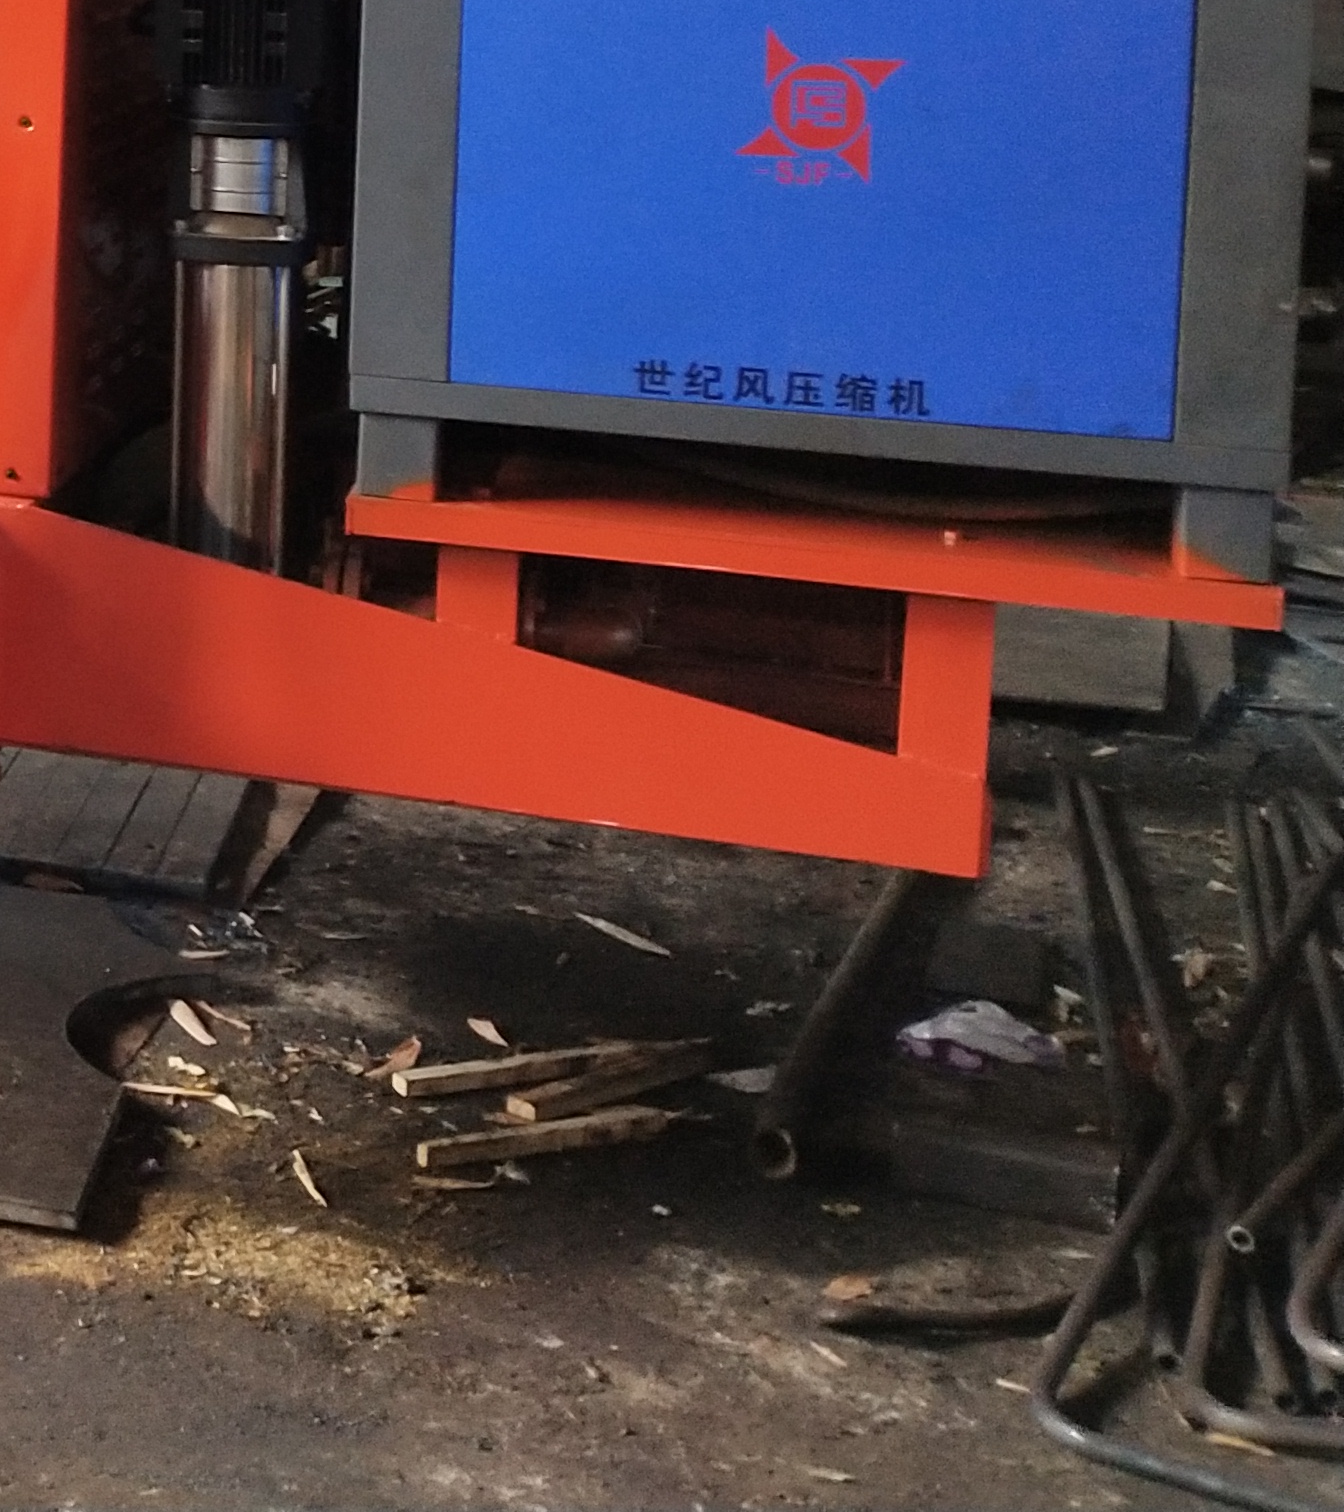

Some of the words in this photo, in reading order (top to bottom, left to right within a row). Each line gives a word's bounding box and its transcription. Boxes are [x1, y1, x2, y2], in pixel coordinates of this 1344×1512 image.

[634, 359, 931, 417] 世纪风压缩机
